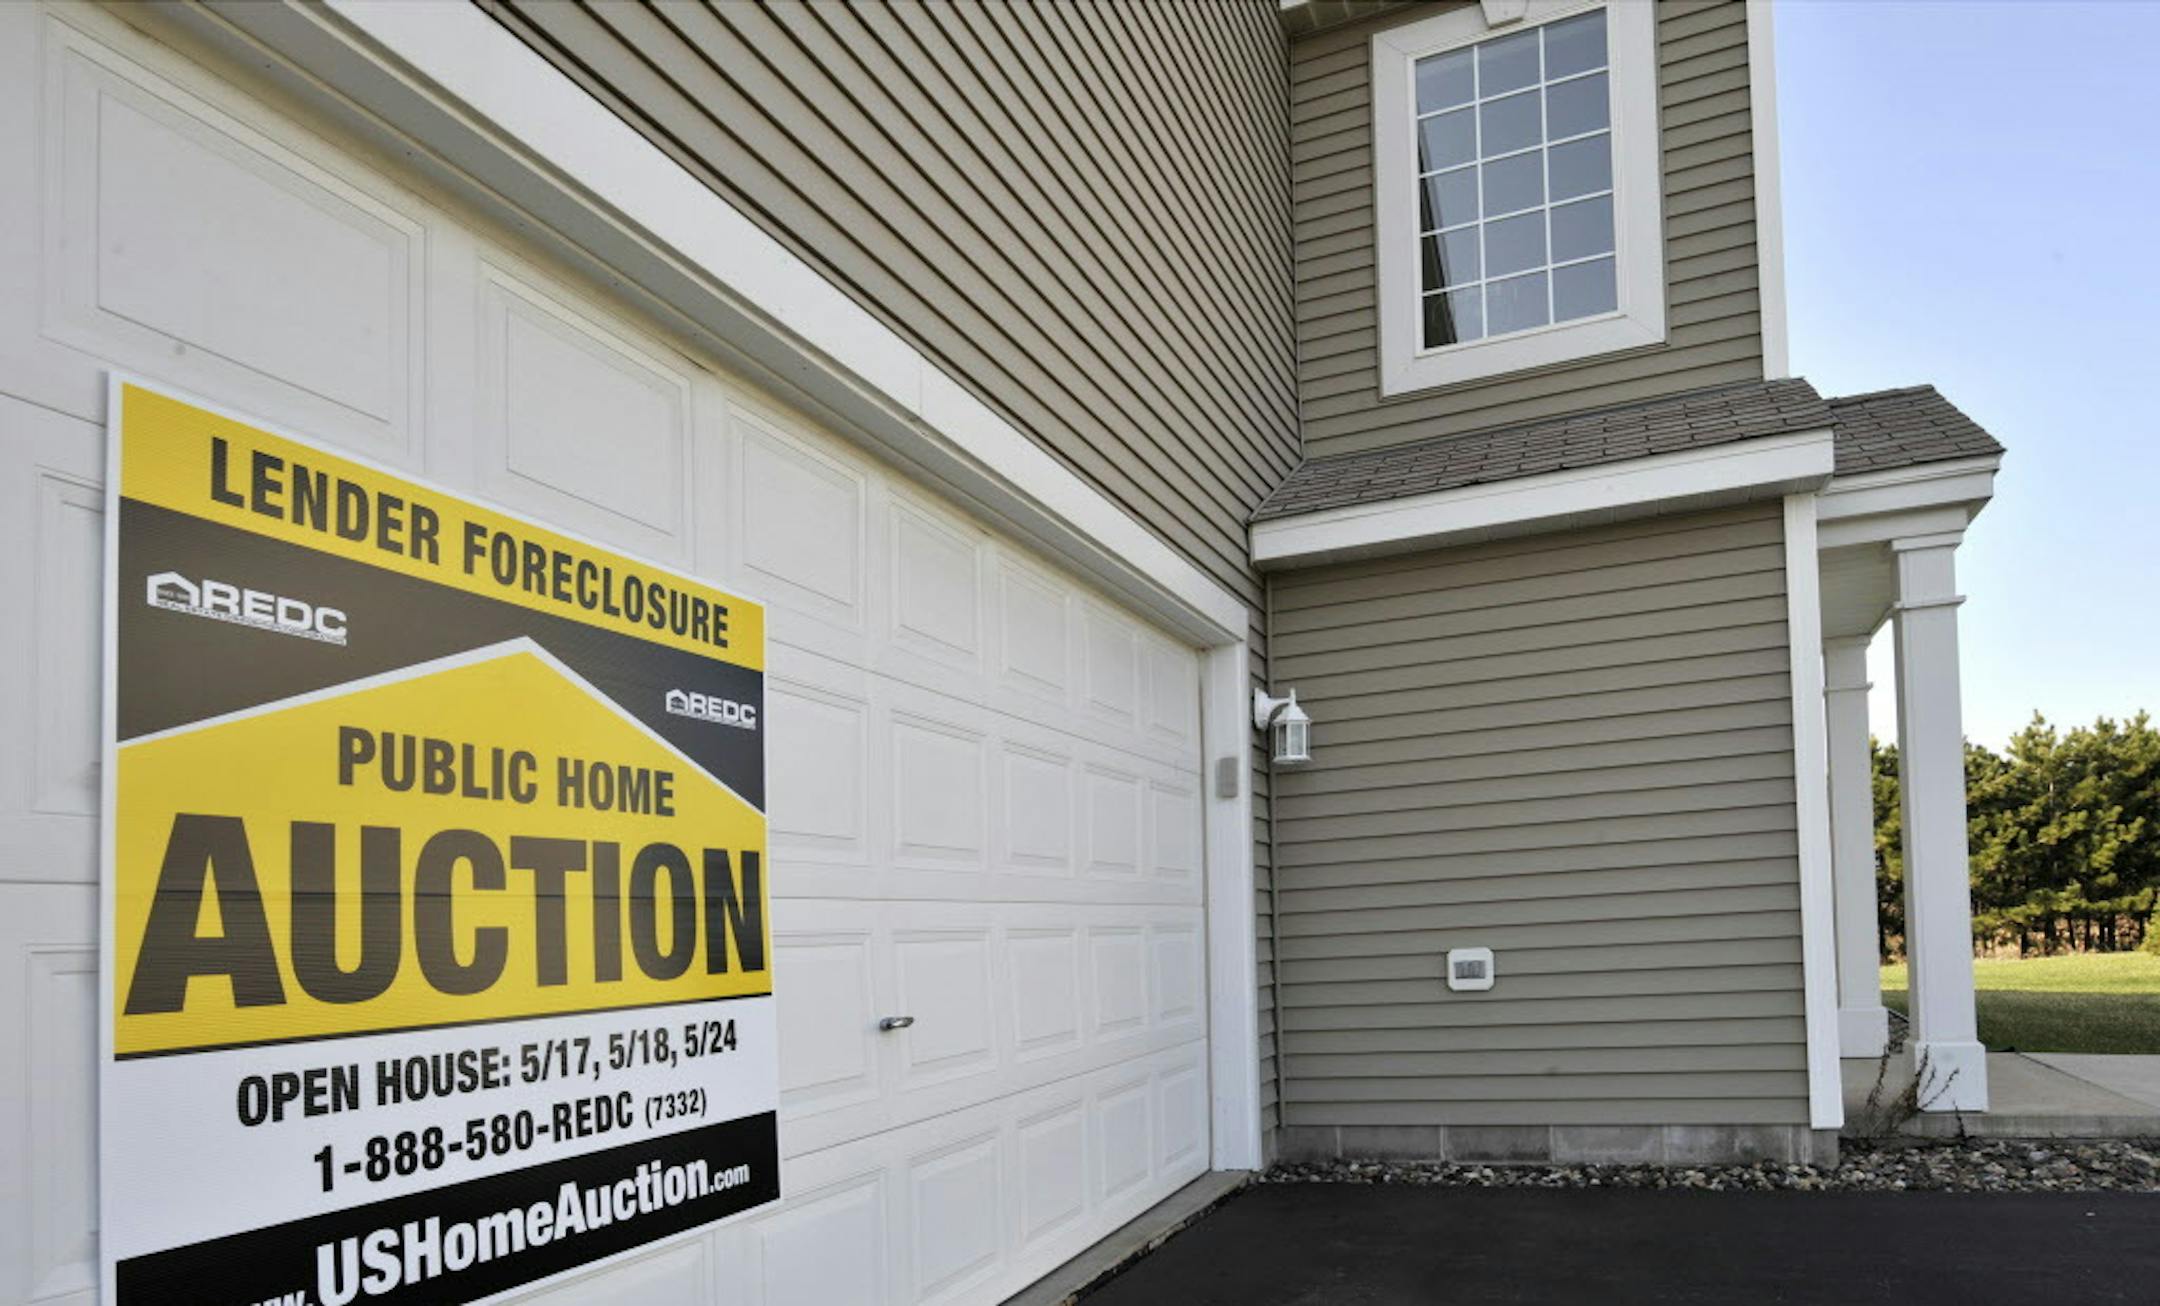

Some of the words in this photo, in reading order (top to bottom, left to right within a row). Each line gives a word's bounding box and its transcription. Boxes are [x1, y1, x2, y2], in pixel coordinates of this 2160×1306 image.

[211, 436, 440, 566] LENDER
[463, 520, 730, 649] FORECLOSURE
[202, 579, 347, 637] REDC
[688, 691, 756, 723] REDC
[338, 725, 538, 804] PUBLIC
[557, 756, 676, 817] HOME
[123, 812, 765, 1016] AUCTION
[237, 1063, 360, 1127] OPEN
[376, 1046, 511, 1106] HOUSE:
[520, 1036, 600, 1083] 5/17,
[608, 1027, 678, 1070] 5/18,
[684, 1019, 737, 1058] 5/24
[314, 1090, 633, 1193] 1-888-580-REDC
[645, 1087, 707, 1129] (7332)
